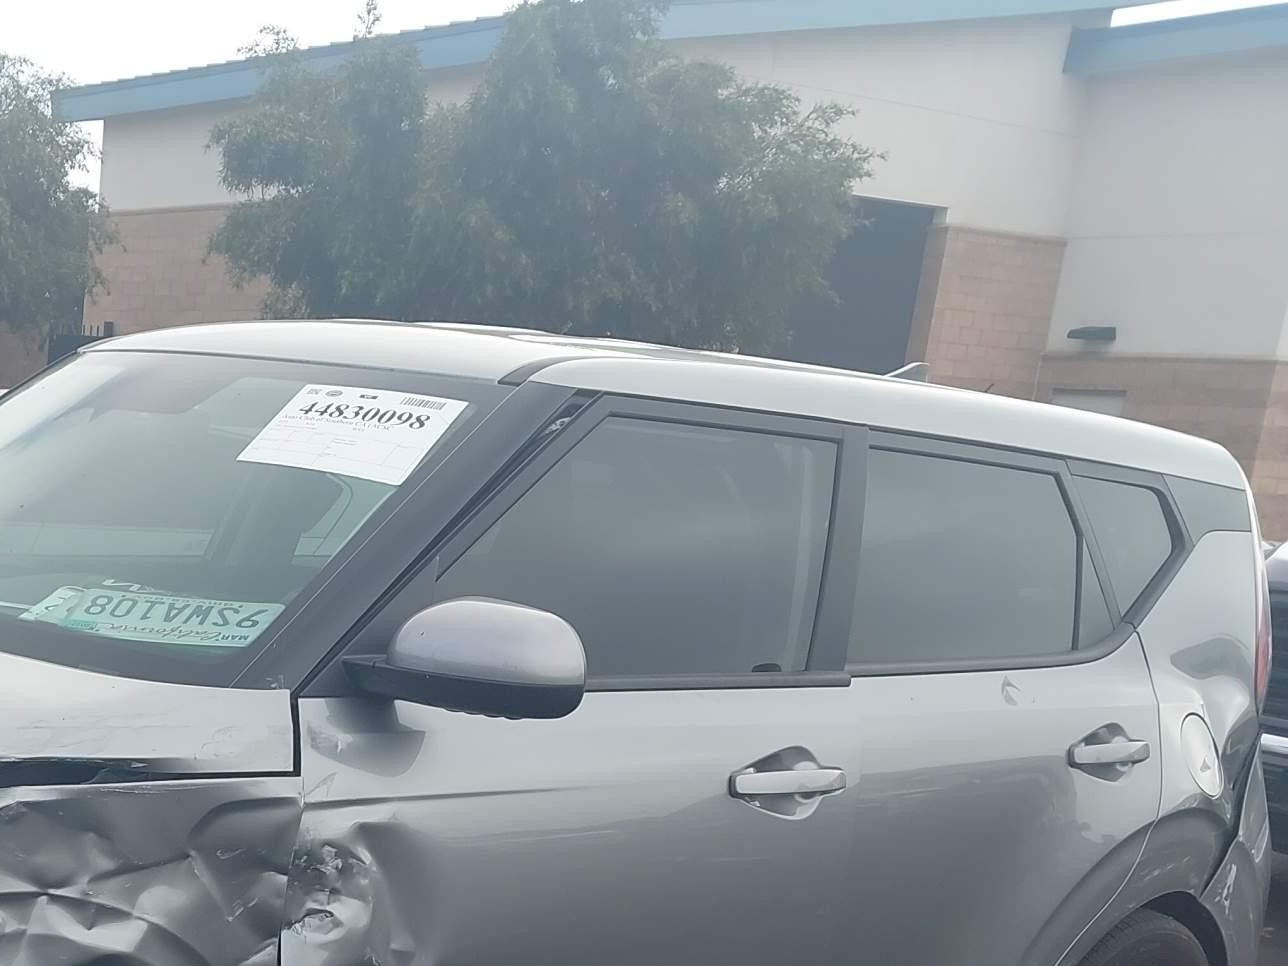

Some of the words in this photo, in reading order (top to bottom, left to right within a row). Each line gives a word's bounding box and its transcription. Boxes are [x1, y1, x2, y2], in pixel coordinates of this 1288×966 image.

[299, 401, 431, 430] 44830098
[83, 595, 269, 629] 9SWA108
[111, 624, 222, 642] California
[221, 633, 250, 641] MAR
